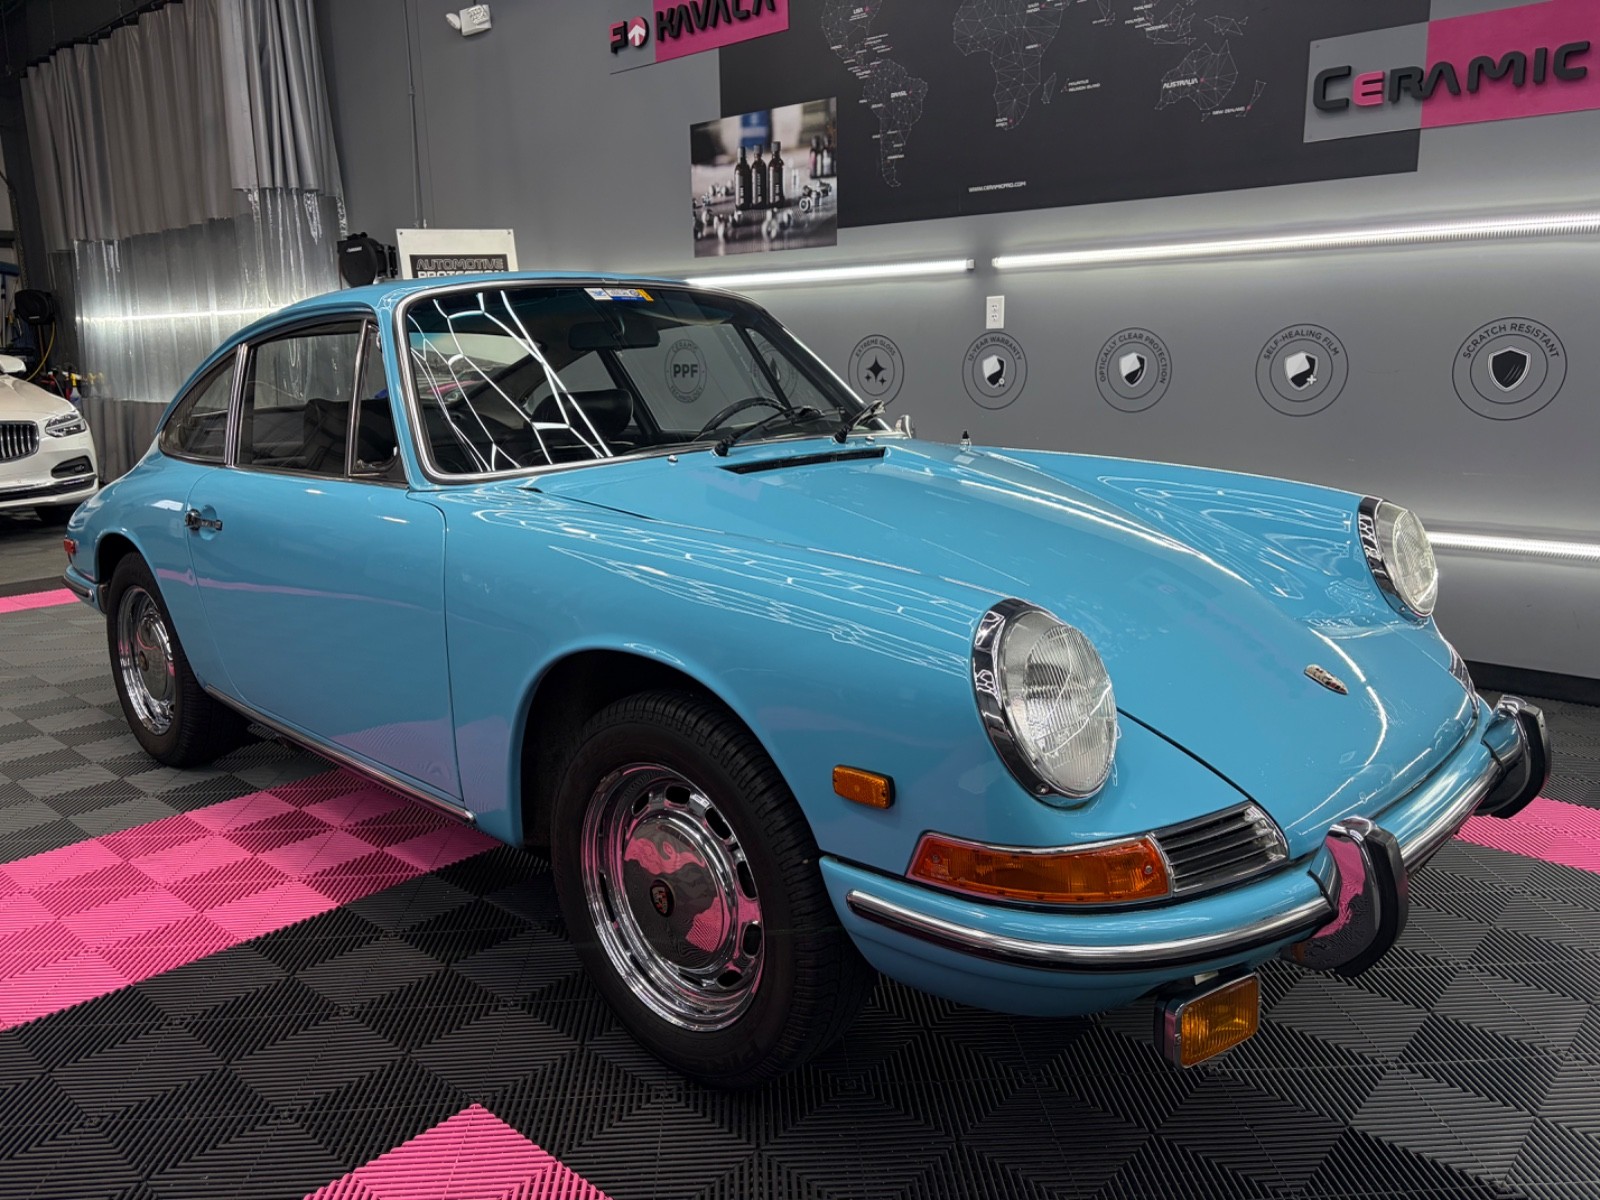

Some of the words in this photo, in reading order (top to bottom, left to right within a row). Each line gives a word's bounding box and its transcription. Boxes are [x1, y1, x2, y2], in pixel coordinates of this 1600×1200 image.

[1162, 78, 1199, 89] AUSTRALIA
[1313, 41, 1590, 112] CERAMIC
[416, 258, 504, 270] AUTOMOTIVE
[855, 338, 878, 357] EXTREME
[879, 340, 896, 356] GLOSS
[990, 336, 1022, 360] WARRANTY
[1264, 329, 1322, 360] SELF-HEALING
[1322, 336, 1340, 356] FILM
[1462, 324, 1507, 359] SCRATCH
[1510, 322, 1560, 358] RESISTANT
[1099, 340, 1117, 382] OPTICALLY
[1118, 332, 1144, 342] CLEAR
[1144, 336, 1168, 384] PROTECTION
[673, 364, 698, 378] PPF
